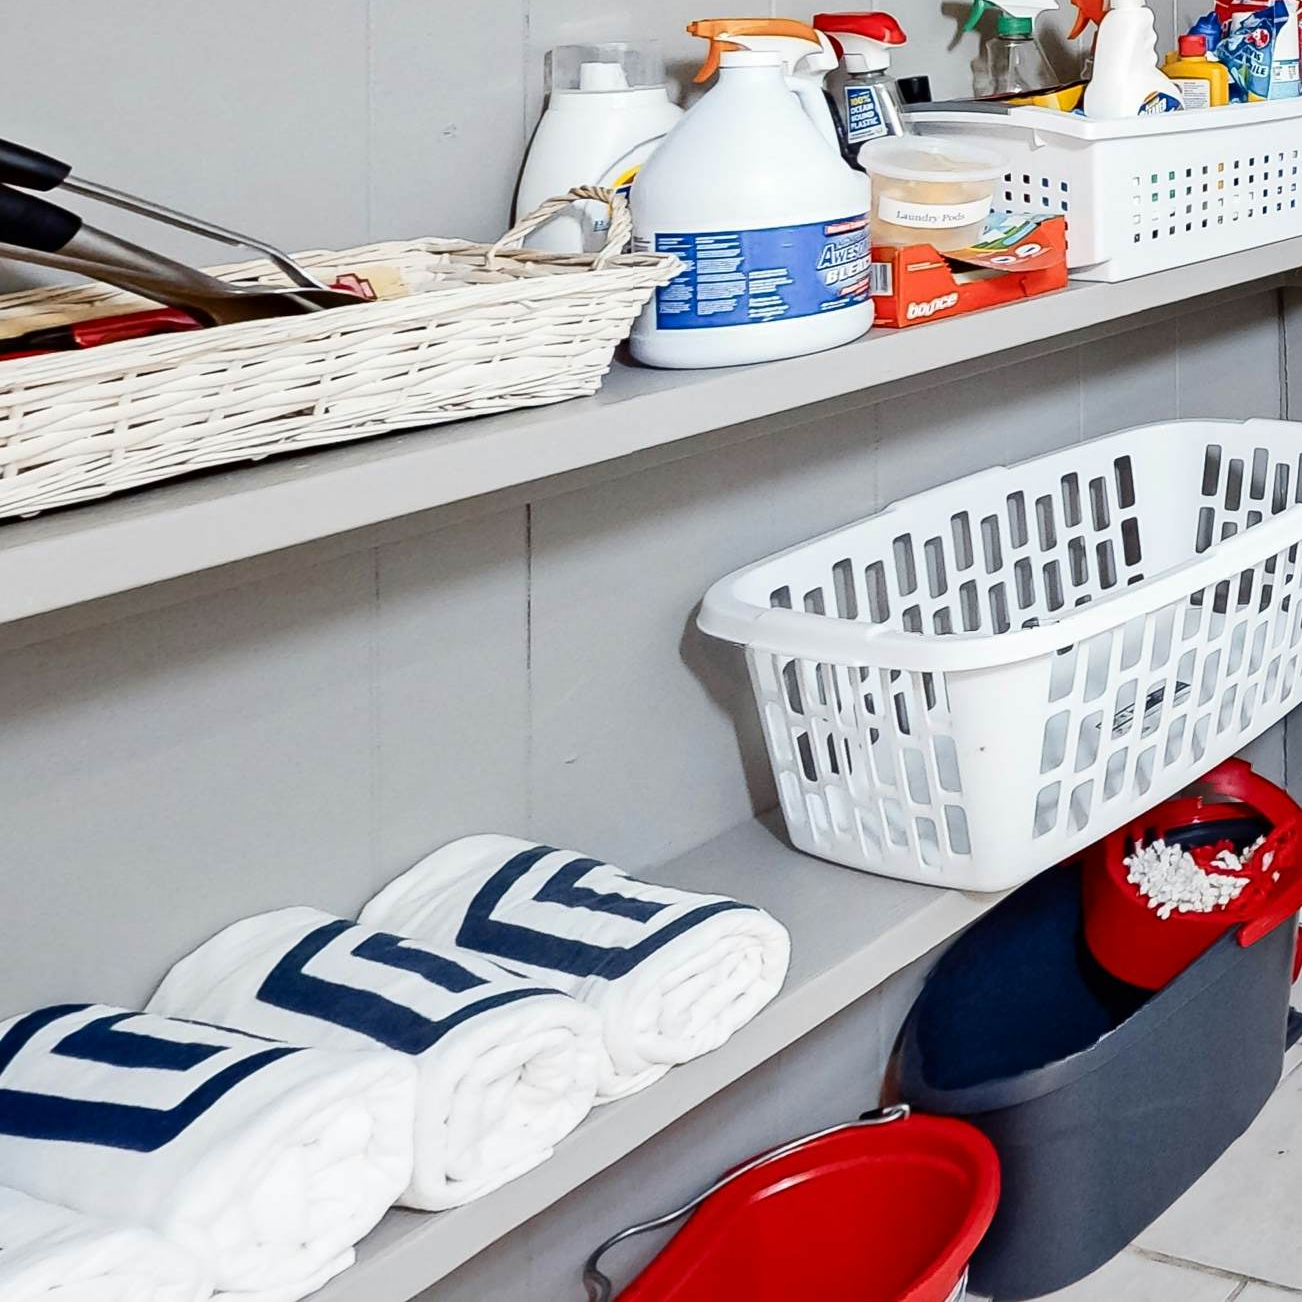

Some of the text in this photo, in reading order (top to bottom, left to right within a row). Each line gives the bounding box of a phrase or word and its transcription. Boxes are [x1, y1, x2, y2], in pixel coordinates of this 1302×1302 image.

[896, 210, 966, 224] Laundry Pods
[906, 292, 959, 320] bounce
